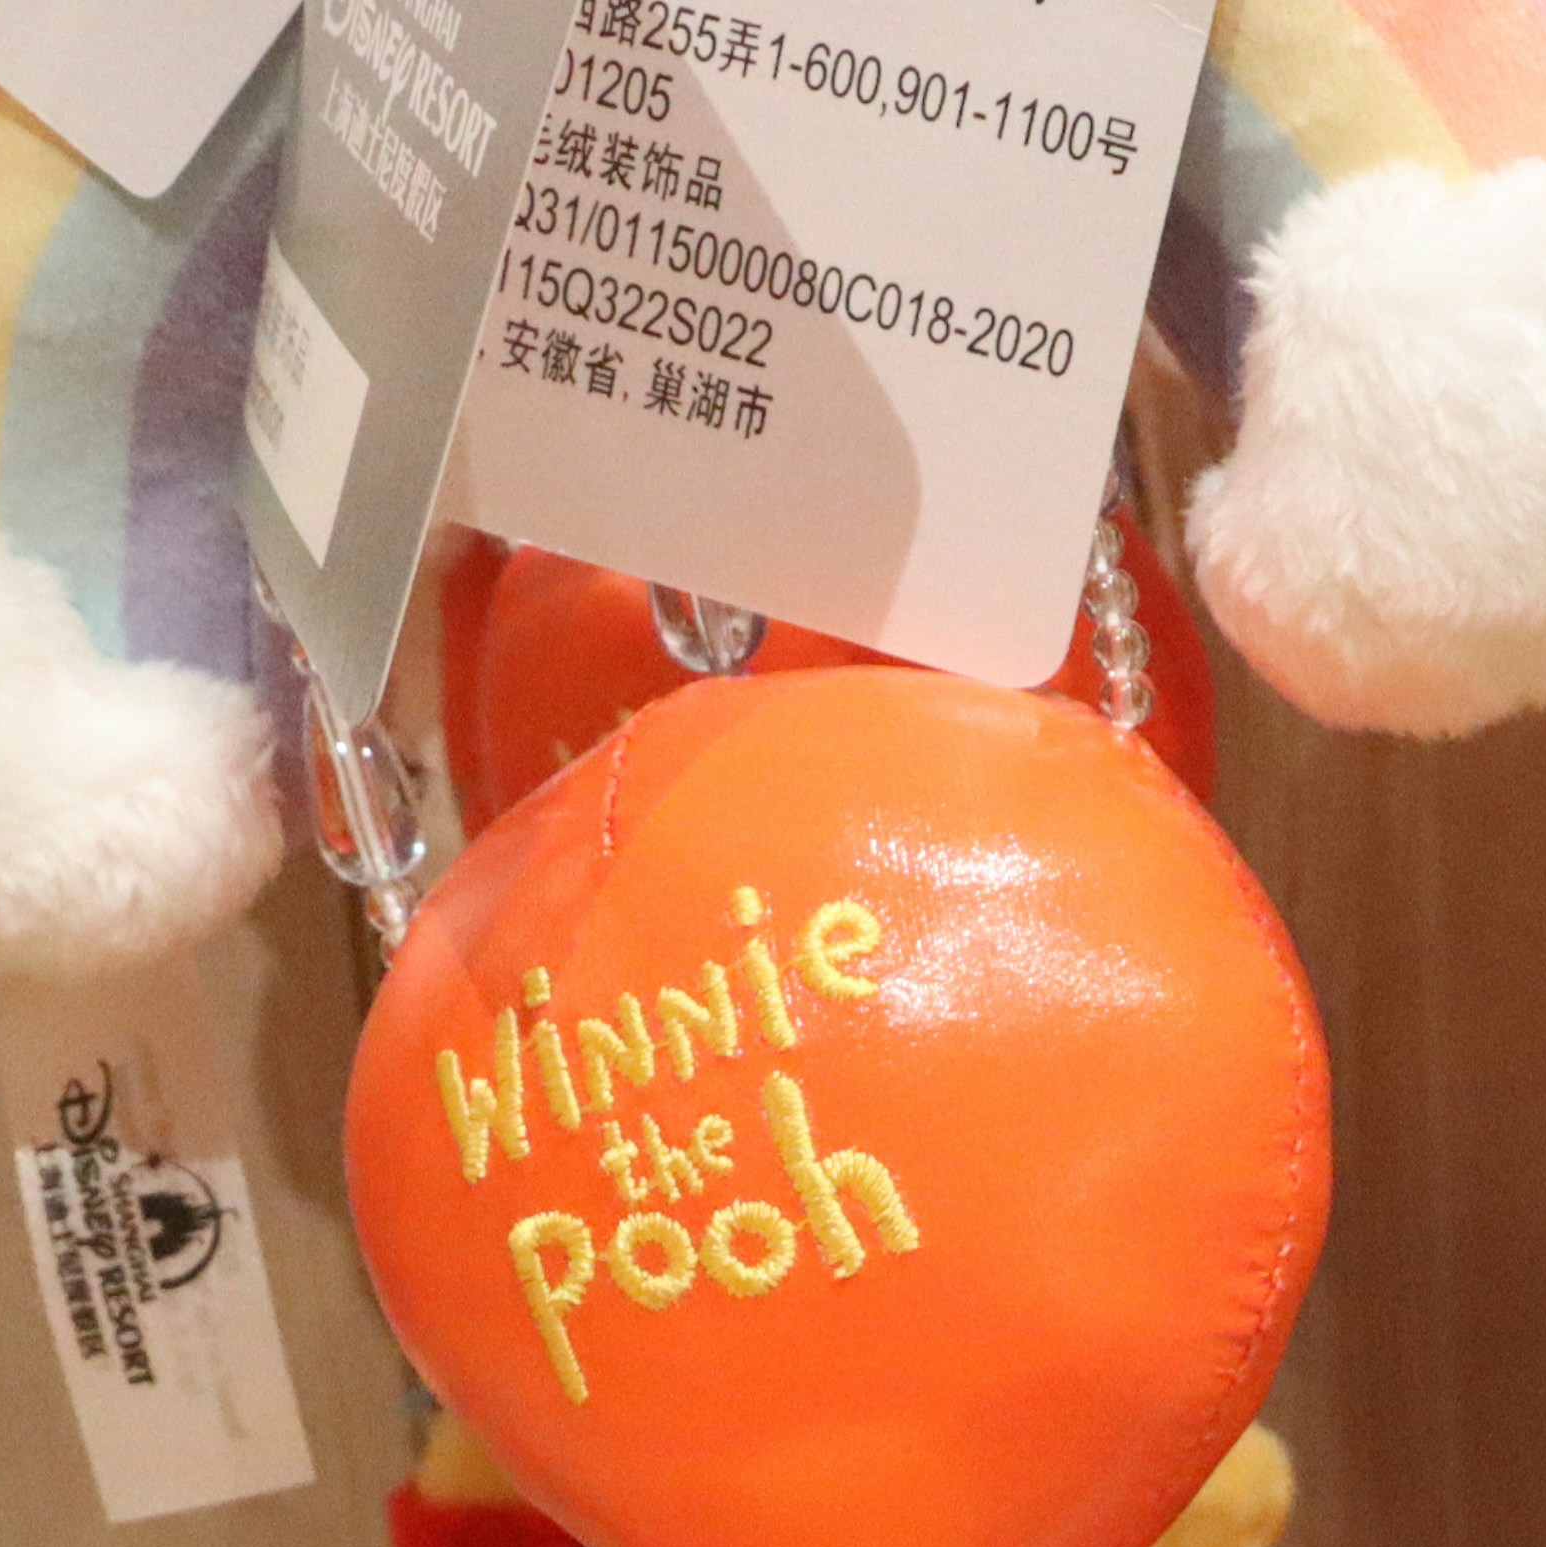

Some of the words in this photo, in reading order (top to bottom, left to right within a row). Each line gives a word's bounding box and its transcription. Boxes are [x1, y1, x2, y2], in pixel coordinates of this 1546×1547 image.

[409, 50, 498, 178] RESORT
[599, 1112, 734, 1205] the
[96, 1264, 157, 1386] RESORT
